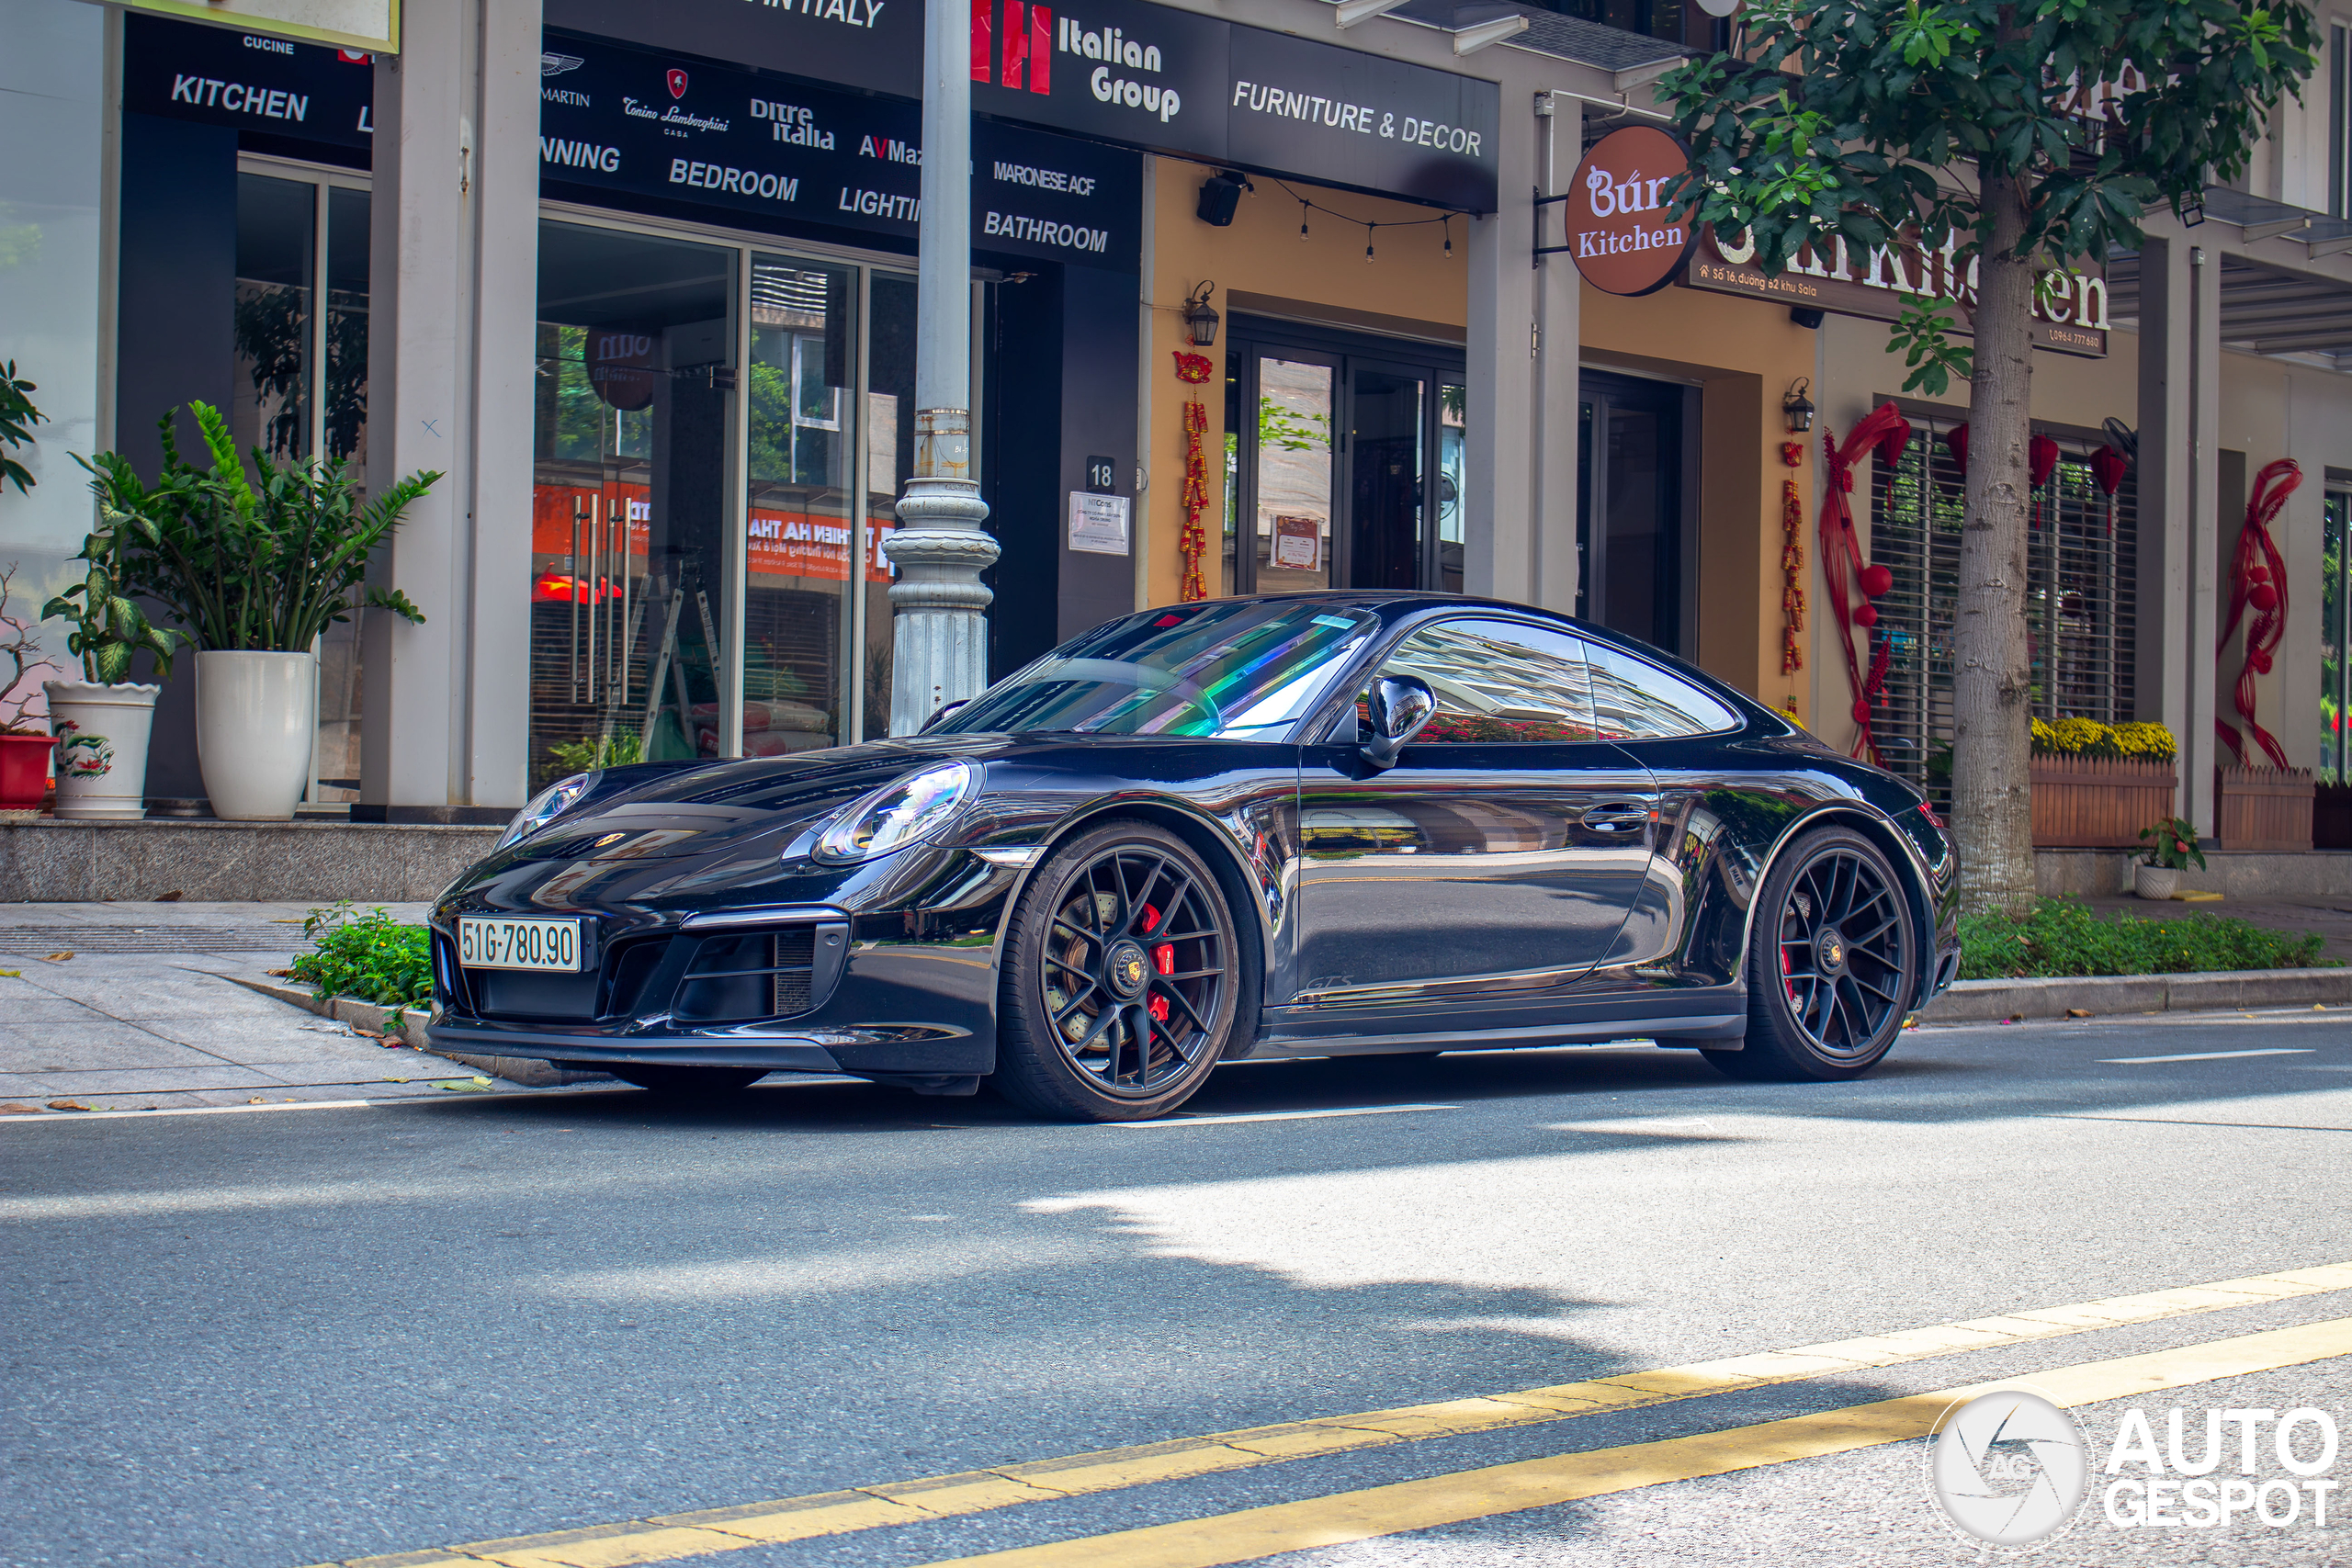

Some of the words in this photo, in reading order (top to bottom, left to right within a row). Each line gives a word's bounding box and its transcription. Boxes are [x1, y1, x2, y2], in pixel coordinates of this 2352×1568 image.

[243, 35, 295, 55] CUCINE
[1058, 17, 1161, 73] Italian
[171, 73, 309, 121] KITCHEN
[540, 87, 590, 107] MARTIN
[1091, 66, 1181, 123] Group
[622, 96, 659, 120] Tonino
[661, 106, 729, 132] Lamborghini
[1232, 80, 1374, 134] FURNITURE
[1378, 112, 1395, 139] &
[1401, 117, 1482, 157] DECOR
[663, 128, 689, 139] CASA
[669, 158, 799, 202] BEDROOM
[993, 161, 1068, 193] MARONESE
[1068, 176, 1096, 197] ACF
[983, 211, 1108, 253] BATHROOM
[1577, 224, 1683, 259] Kitchen
[1713, 267, 1724, 282] Số
[1781, 278, 1795, 293] khu
[1797, 282, 1817, 297] Sala
[1091, 464, 1112, 487] 18
[462, 922, 573, 965] 51G-780.90
[1306, 975, 1354, 990] GTS
